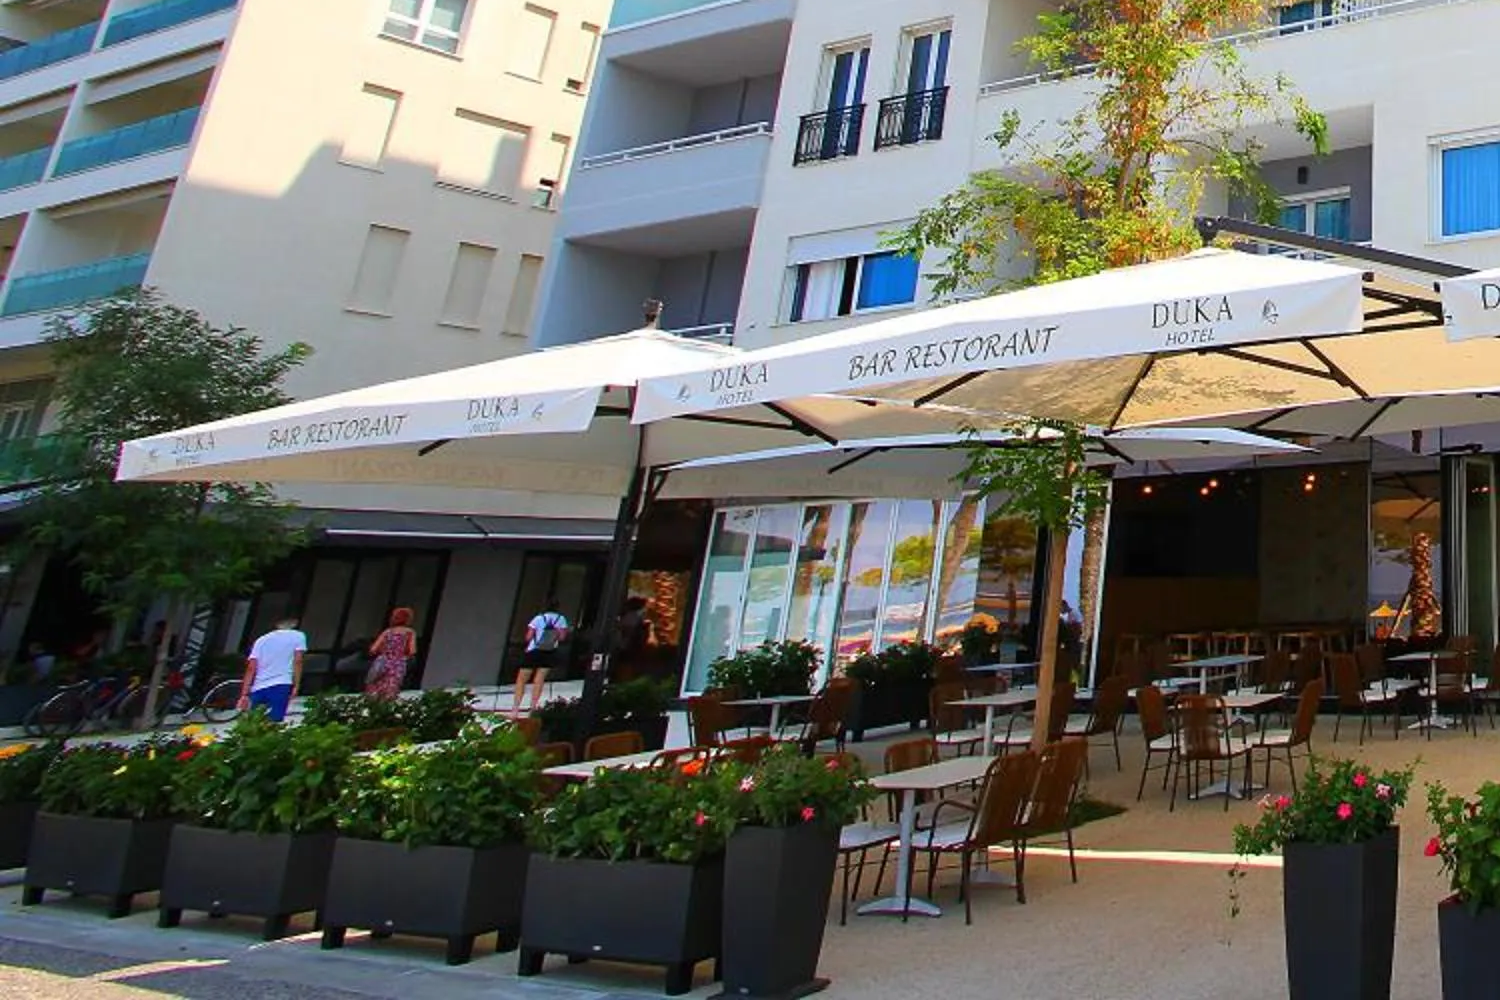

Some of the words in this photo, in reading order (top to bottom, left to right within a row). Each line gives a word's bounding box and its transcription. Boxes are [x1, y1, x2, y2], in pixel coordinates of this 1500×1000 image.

[1152, 295, 1233, 329] DUKA
[848, 349, 897, 381] BAR
[904, 325, 1060, 373] RESTORANT
[1165, 328, 1216, 346] HOTEL
[710, 362, 768, 393] DUKA
[466, 396, 520, 420] DUKA
[267, 424, 302, 450] BAR
[303, 415, 408, 446] RESTORANT
